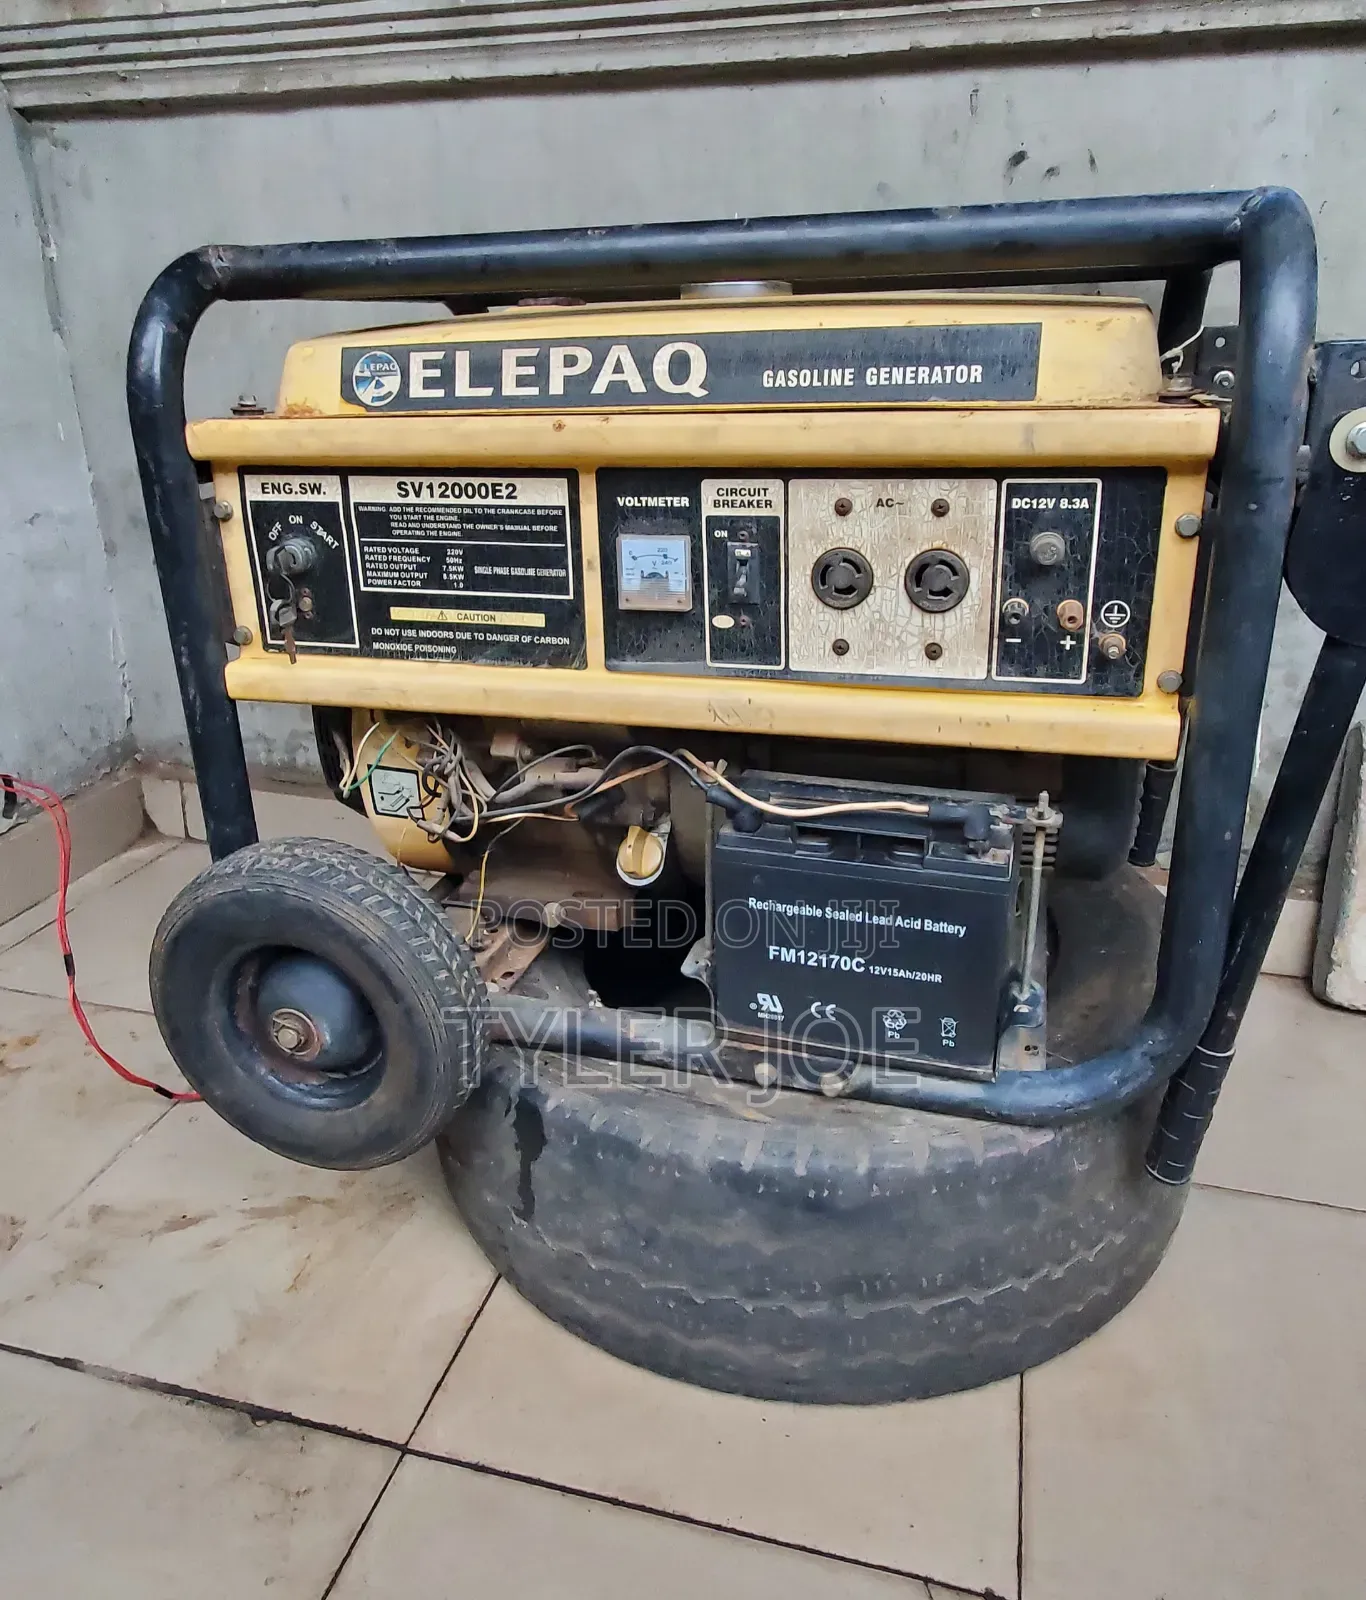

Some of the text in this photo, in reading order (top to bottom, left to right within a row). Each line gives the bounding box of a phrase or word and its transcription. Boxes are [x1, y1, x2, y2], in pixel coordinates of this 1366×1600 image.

[409, 342, 709, 398] ELEPAQ
[763, 364, 982, 388] GASOLINE GENERATOR
[261, 482, 326, 495] ENG.SW.
[397, 481, 517, 499] SV12000E2
[717, 488, 769, 497] CIRCUIT
[617, 496, 689, 507] VOLTMETER
[713, 499, 772, 508] BREAKER
[1012, 498, 1089, 509] DC12V 8.3A
[289, 515, 302, 524] ON
[268, 521, 282, 540] OFF
[310, 521, 339, 549] START
[714, 530, 728, 538] ON
[447, 548, 463, 556] 220V
[389, 555, 430, 563] FREQUENCY
[493, 567, 509, 575] PHASE
[511, 567, 535, 576] GASOLINE
[537, 568, 566, 577] GENERATOR
[457, 612, 496, 622] CAUTION
[384, 628, 399, 636] NOT
[402, 629, 417, 637] USE
[419, 630, 454, 639] INDOORS
[486, 633, 519, 642] DANGER
[521, 635, 532, 643] OF
[534, 636, 569, 645] CARBON
[373, 642, 456, 653] MONOXIDE POISONING
[749, 897, 966, 937] Rechargeable Sealed Lead Acid Battery
[768, 945, 942, 984] FM12170C 12V15Ah/20HR
[811, 1001, 837, 1021] CE
[888, 1031, 900, 1040] Pb
[942, 1039, 954, 1047] Pb
